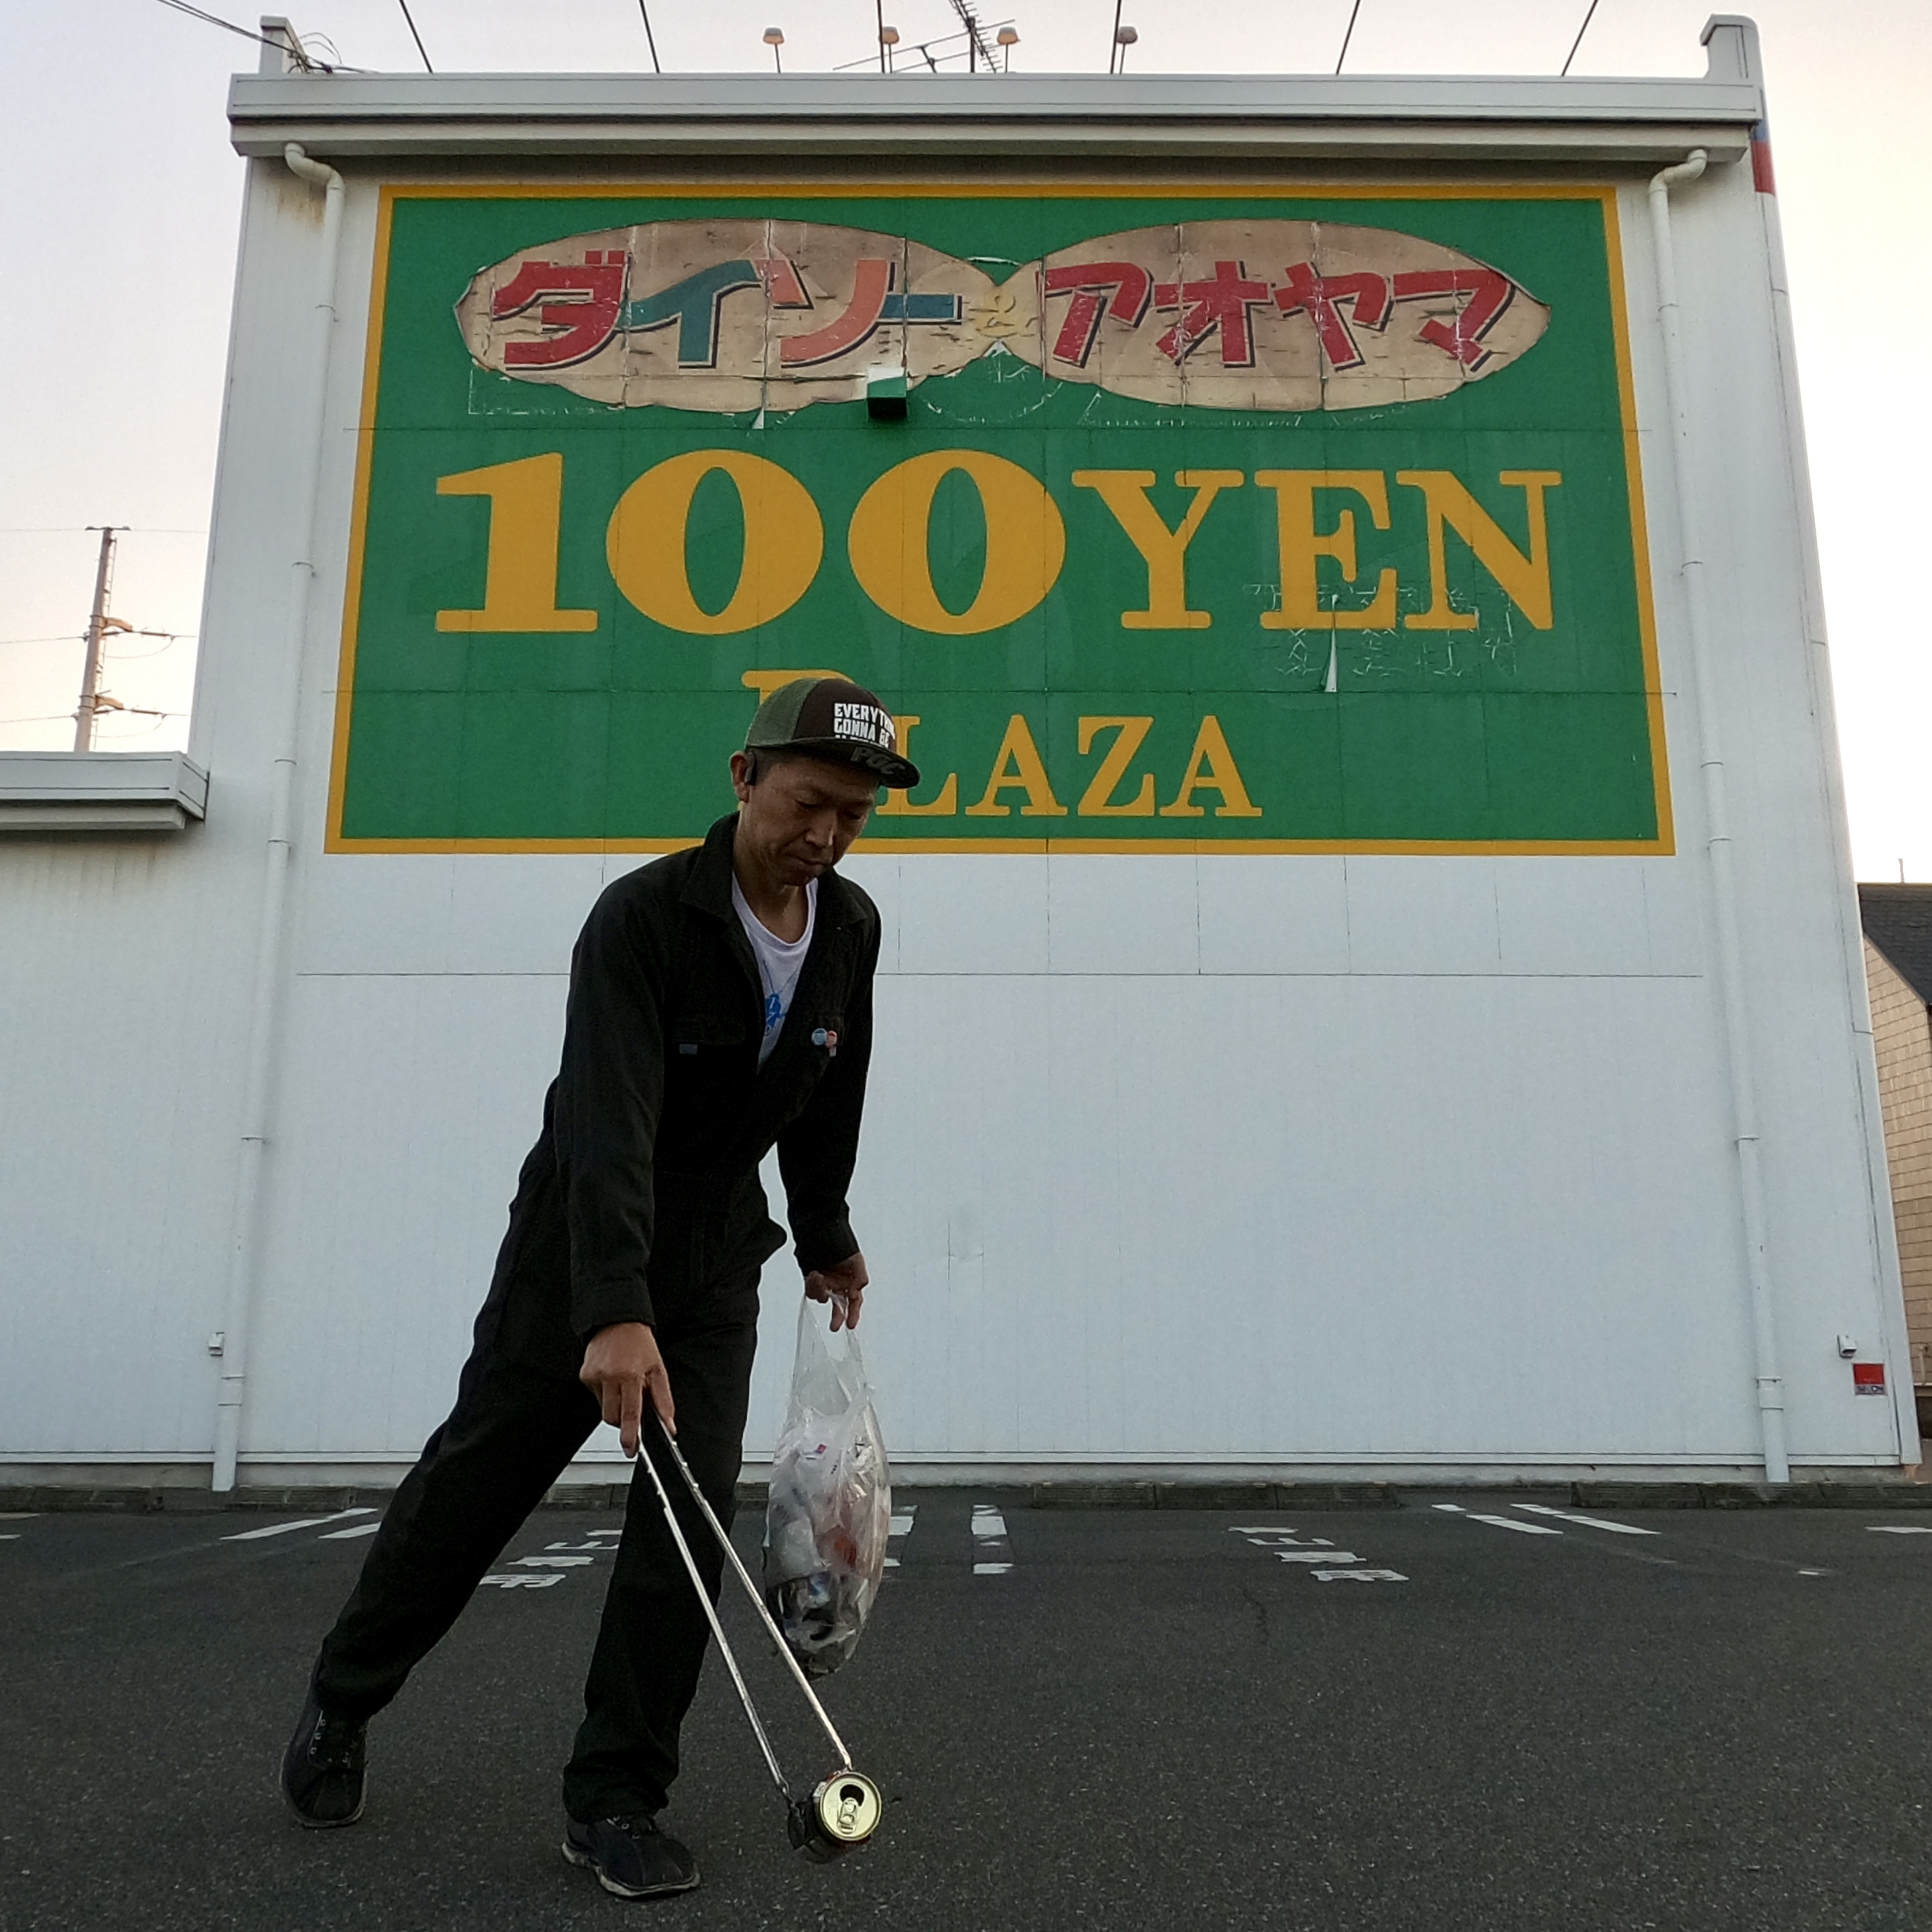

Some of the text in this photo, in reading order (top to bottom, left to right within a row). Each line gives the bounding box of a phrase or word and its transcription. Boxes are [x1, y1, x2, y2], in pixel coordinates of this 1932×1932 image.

[492, 249, 1515, 372] ダイソー アオヤマ
[741, 669, 1263, 819] LAZA
[834, 703, 896, 740] EVERYTH
